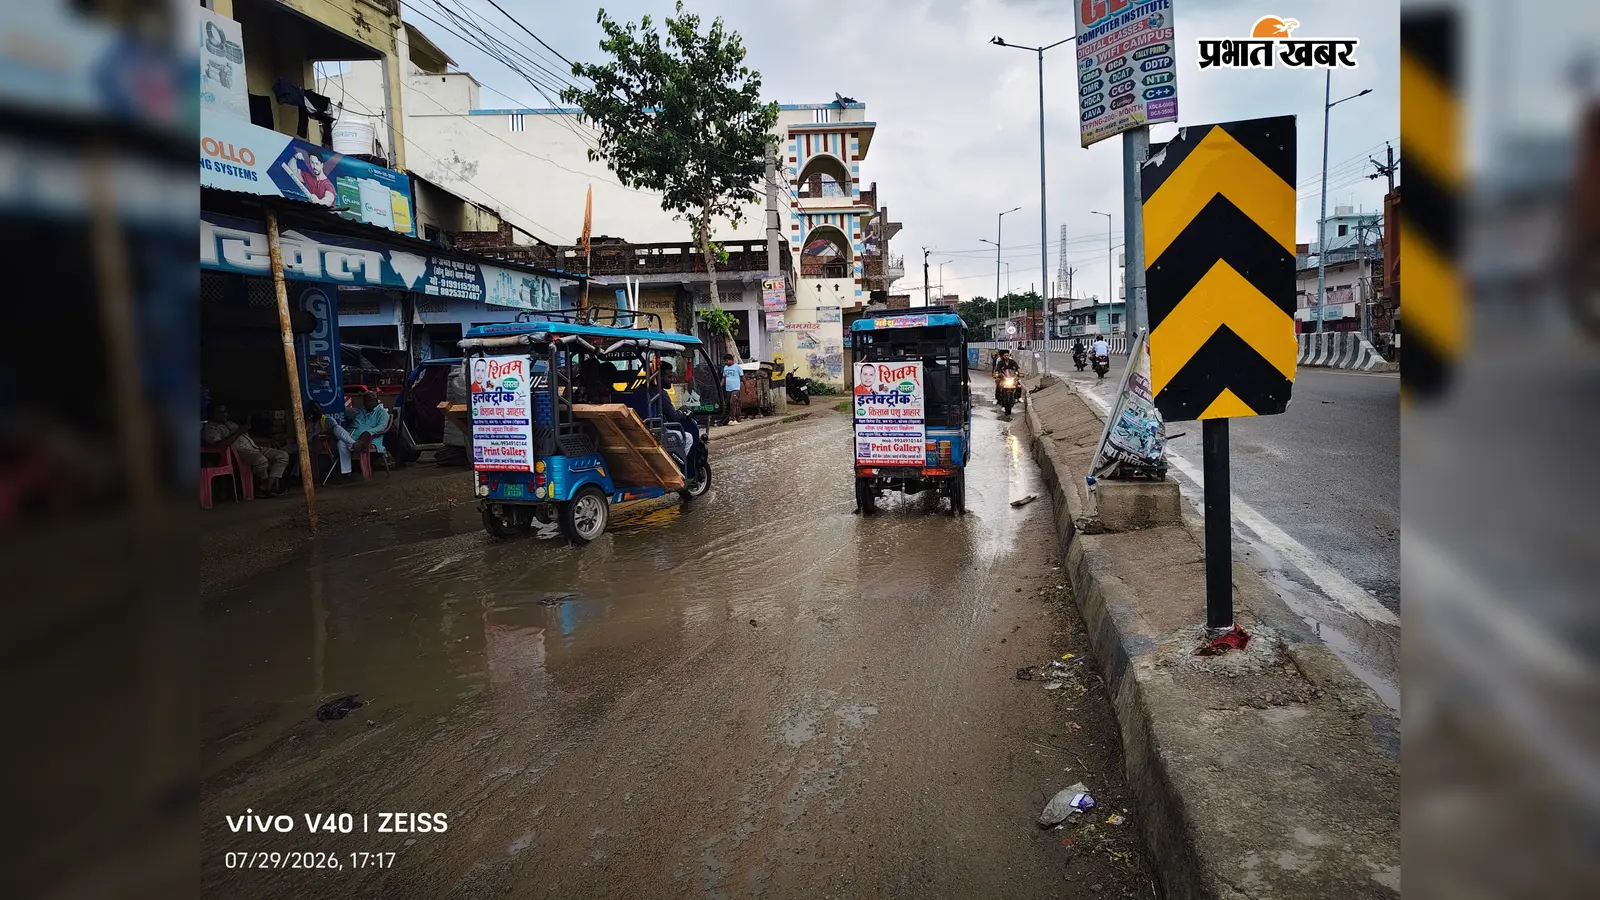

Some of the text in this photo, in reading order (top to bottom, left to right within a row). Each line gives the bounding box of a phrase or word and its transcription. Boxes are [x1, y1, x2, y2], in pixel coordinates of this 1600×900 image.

[1077, 0, 1169, 46] COMPUTER INSTITUTE
[1077, 22, 1143, 58] DIGITAL CLASSES
[1100, 29, 1173, 61] WIFI CAMPUS
[1108, 58, 1123, 70] DCA
[1145, 58, 1170, 70] DDTP
[1112, 68, 1130, 82] DCAT
[1146, 73, 1169, 84] NTT
[1083, 82, 1099, 95] DMR
[1111, 82, 1131, 96] CCC
[1146, 88, 1170, 98] C++
[1084, 94, 1100, 107] HDCA
[1084, 107, 1101, 120] JAVA
[213, 161, 258, 182] SYSTEMS
[868, 406, 888, 416] किसान
[902, 408, 921, 416] आहार
[483, 446, 526, 458] Print Gallery
[871, 443, 922, 453] Print Gallery
